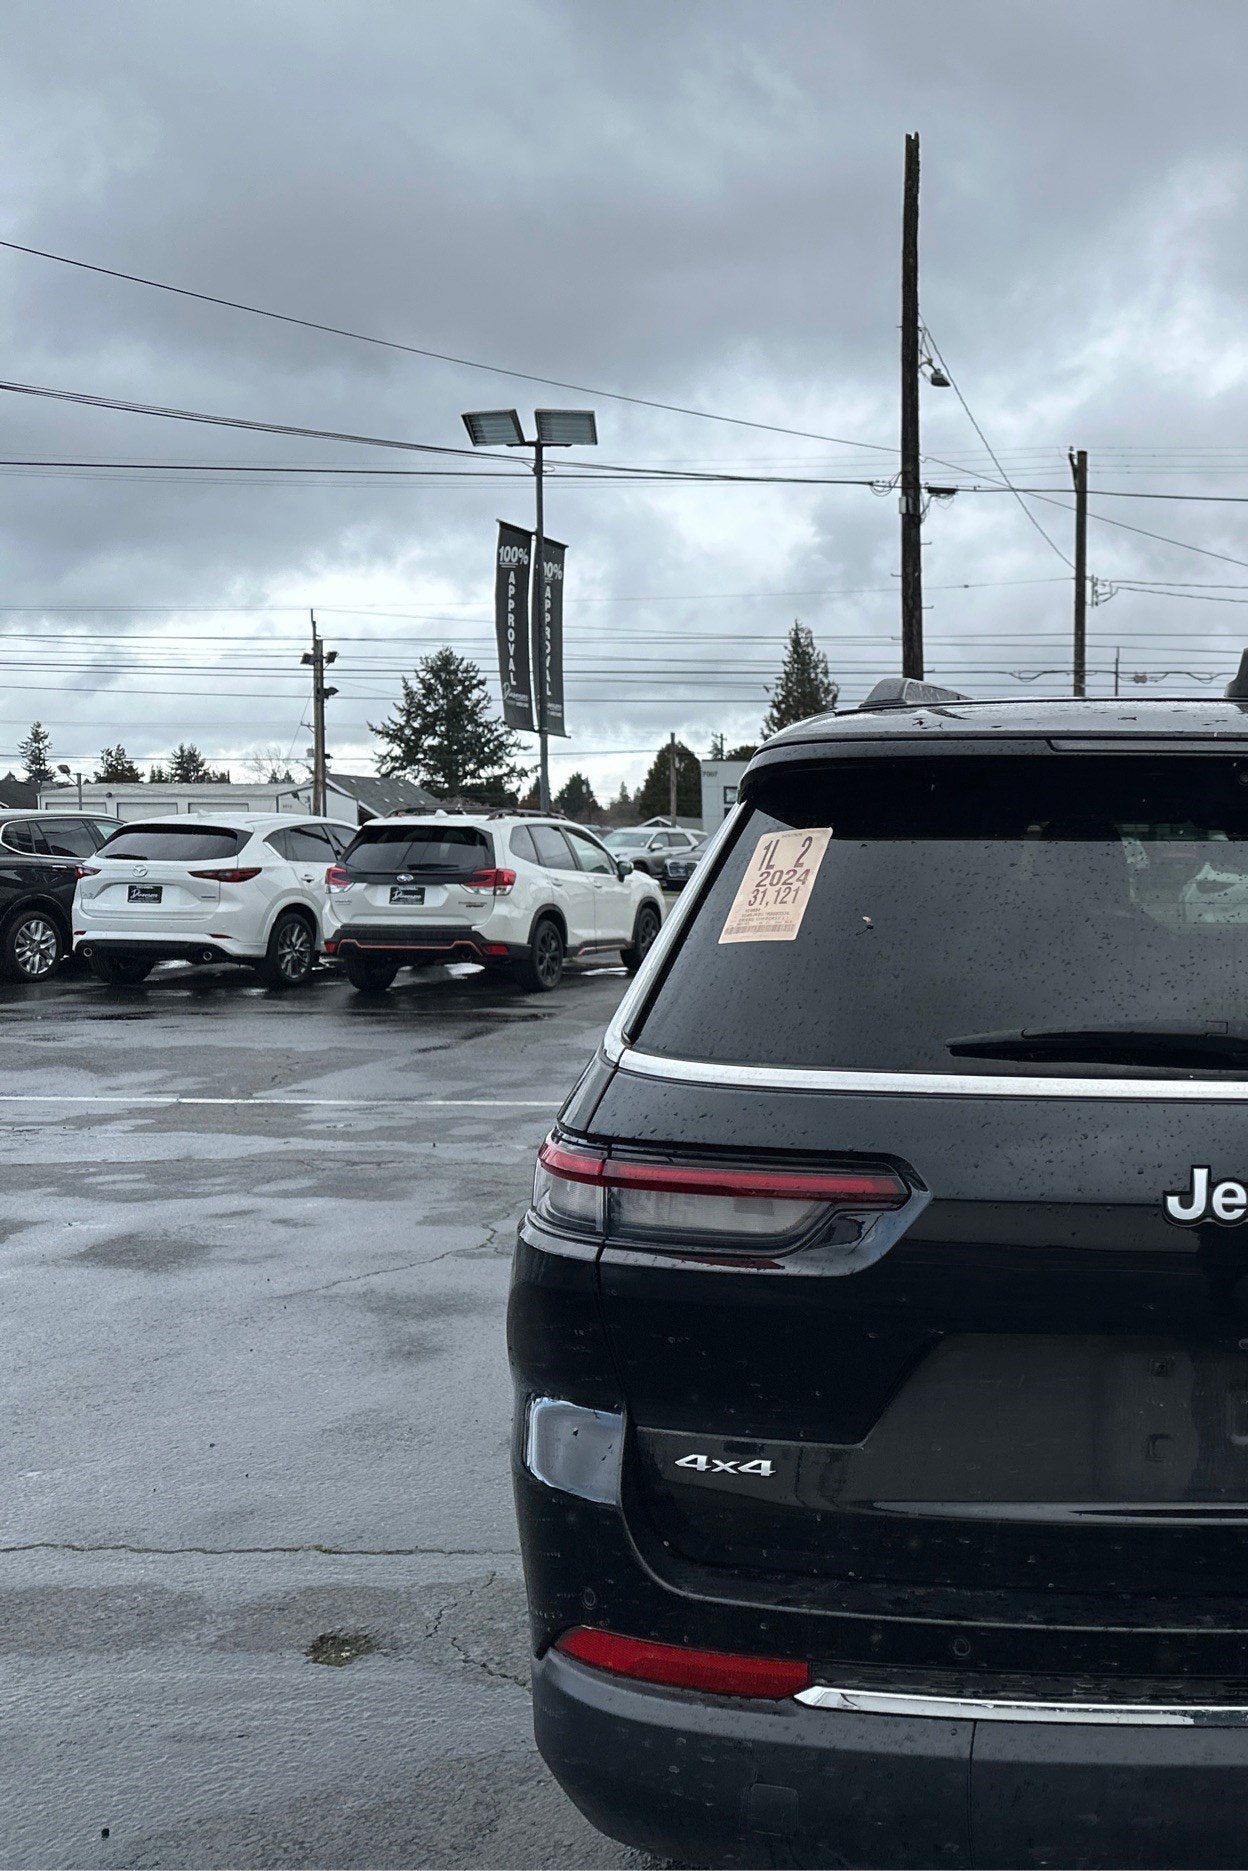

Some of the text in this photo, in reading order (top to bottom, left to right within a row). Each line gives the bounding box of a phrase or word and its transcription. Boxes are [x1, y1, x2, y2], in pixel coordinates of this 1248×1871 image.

[499, 545, 529, 565] 100%
[507, 570, 517, 686] APPROVAL
[793, 836, 813, 868] 2
[755, 868, 811, 888] 2024
[748, 886, 801, 908] 31,121
[674, 1453, 777, 1477] 4x4
